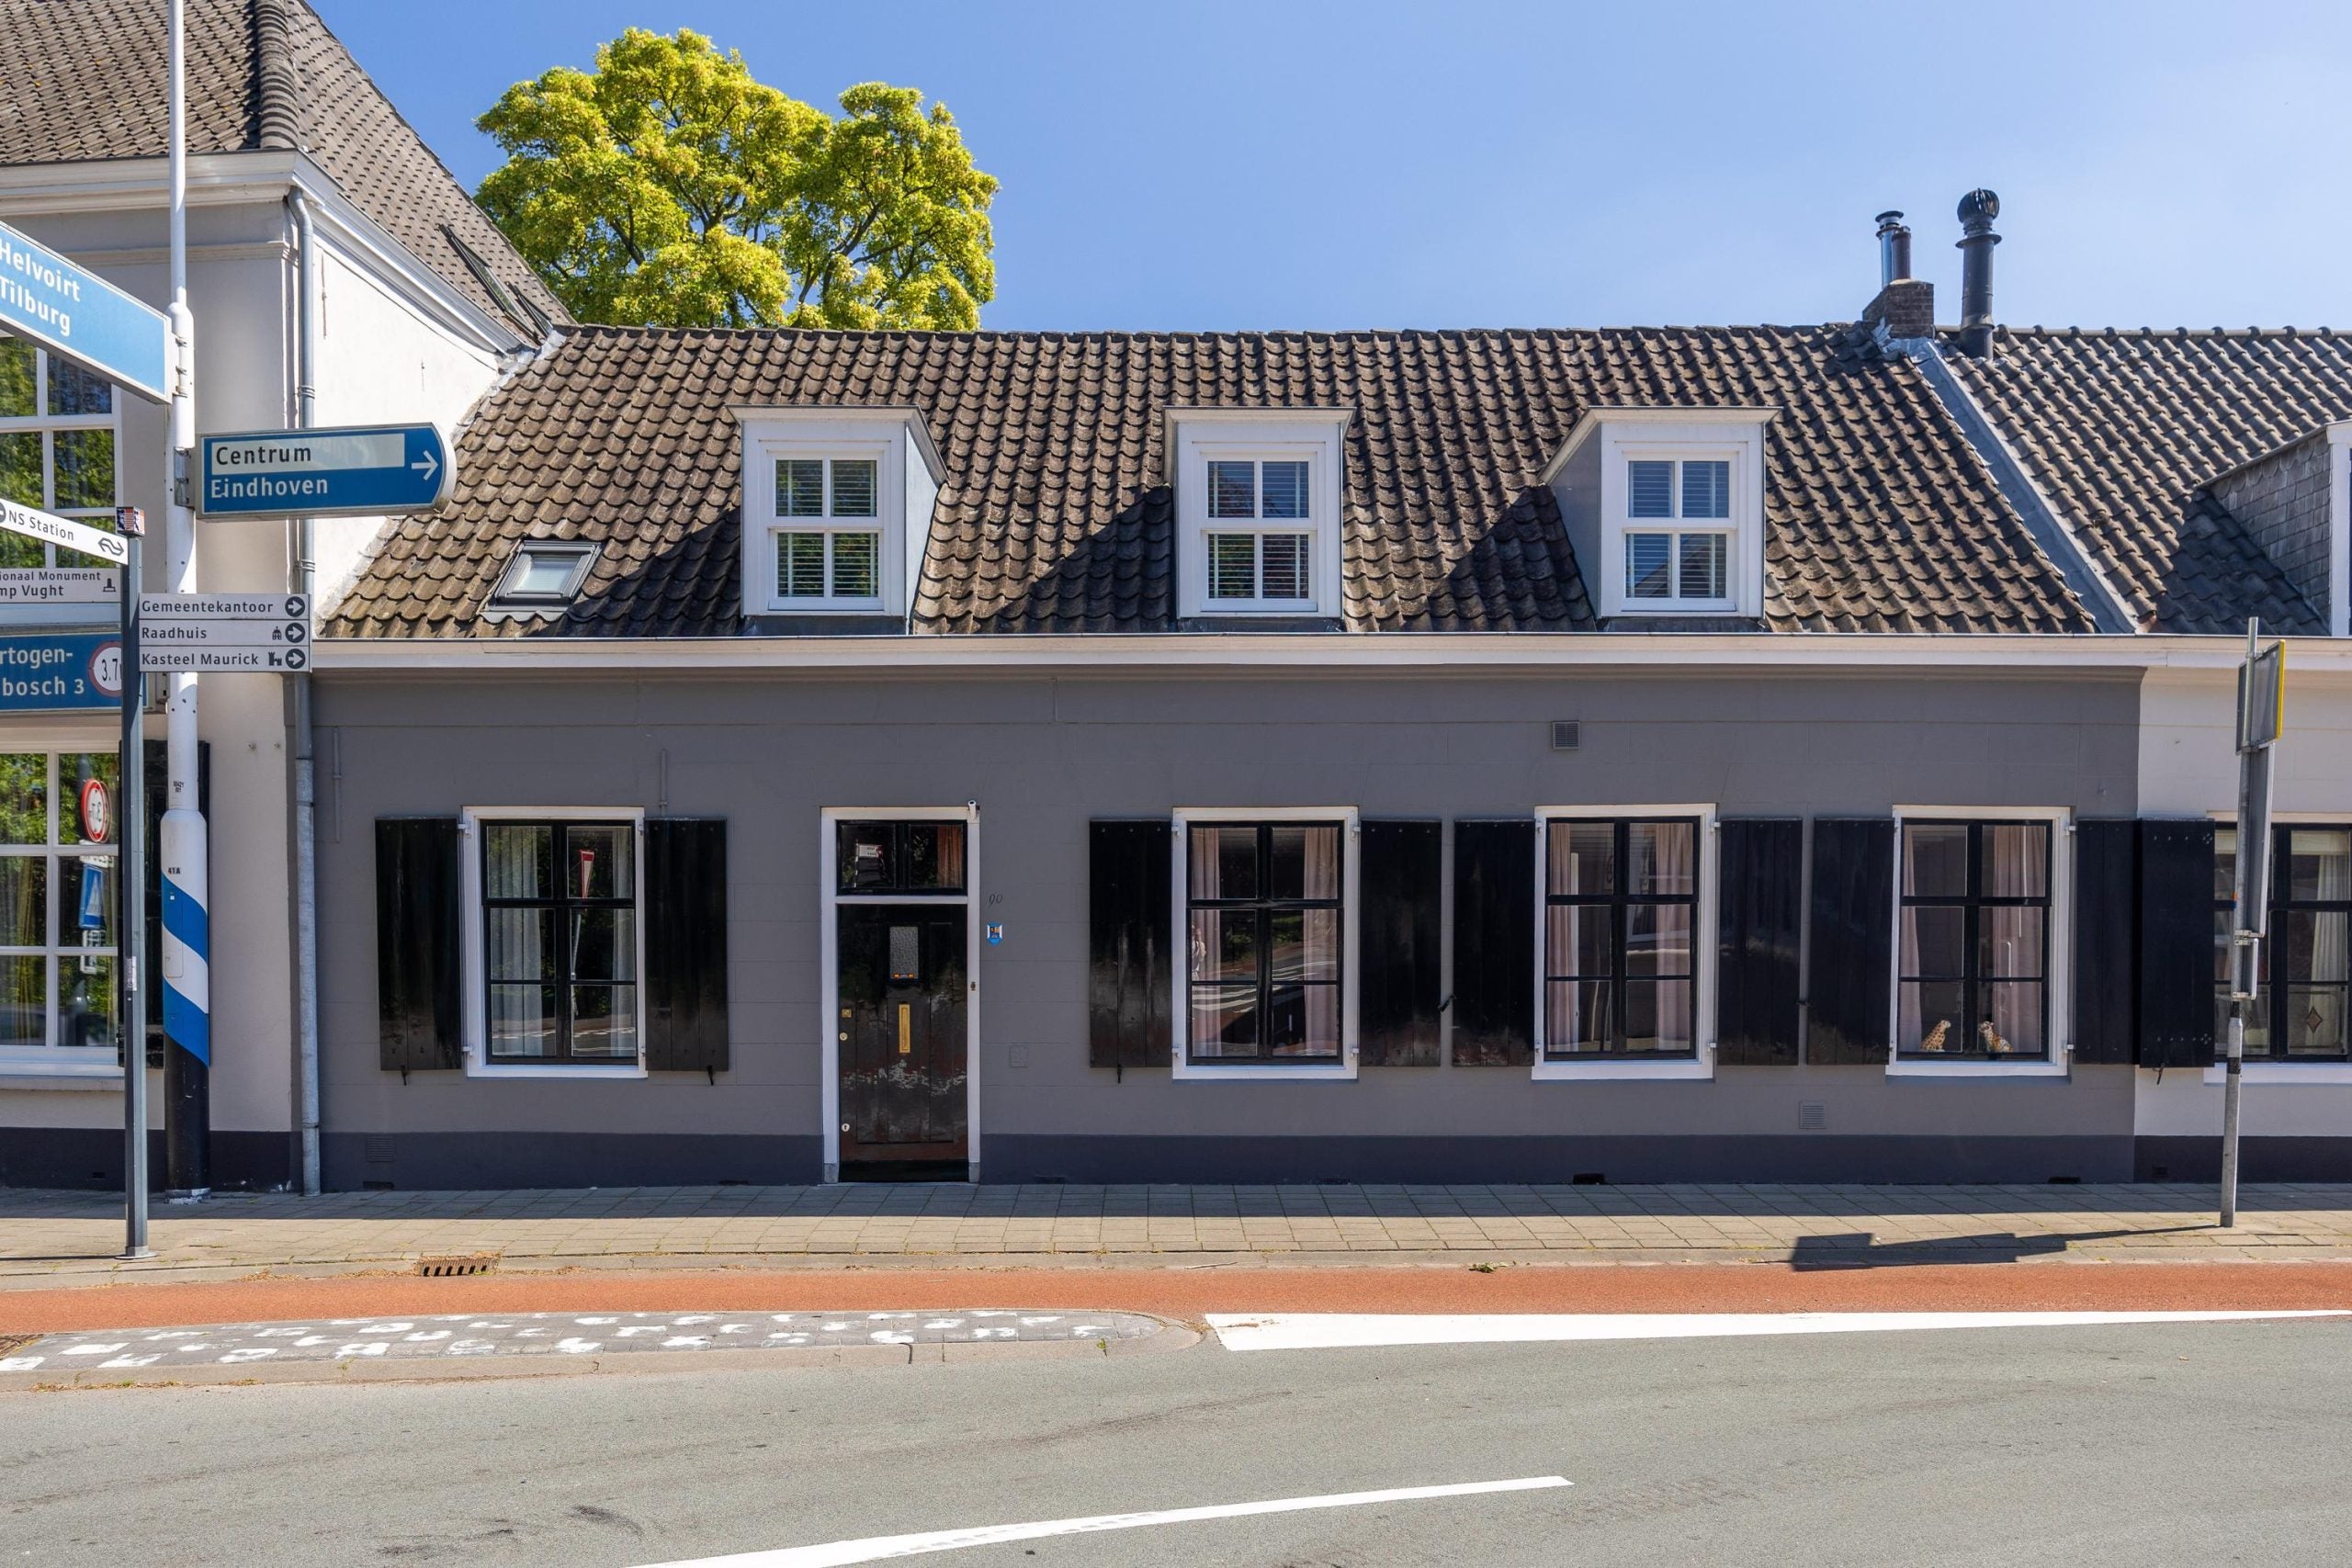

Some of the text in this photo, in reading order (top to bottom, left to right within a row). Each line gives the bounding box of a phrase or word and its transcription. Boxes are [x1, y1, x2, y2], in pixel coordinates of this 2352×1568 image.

[0, 238, 80, 302] Helvoirt
[0, 276, 71, 337] Tilburg
[216, 446, 311, 466] Centrum
[210, 477, 328, 499] Eindhoven
[8, 510, 74, 541] NS Station
[39, 571, 101, 581] Monument
[21, 585, 64, 599] Vught
[141, 601, 274, 613] Gemeentekantoor
[141, 627, 207, 639] Raadhuis
[141, 653, 259, 665] Kasteel Maurick
[101, 658, 122, 682] 3.7
[2, 676, 85, 696] bosch 3
[989, 893, 1003, 908] 90
